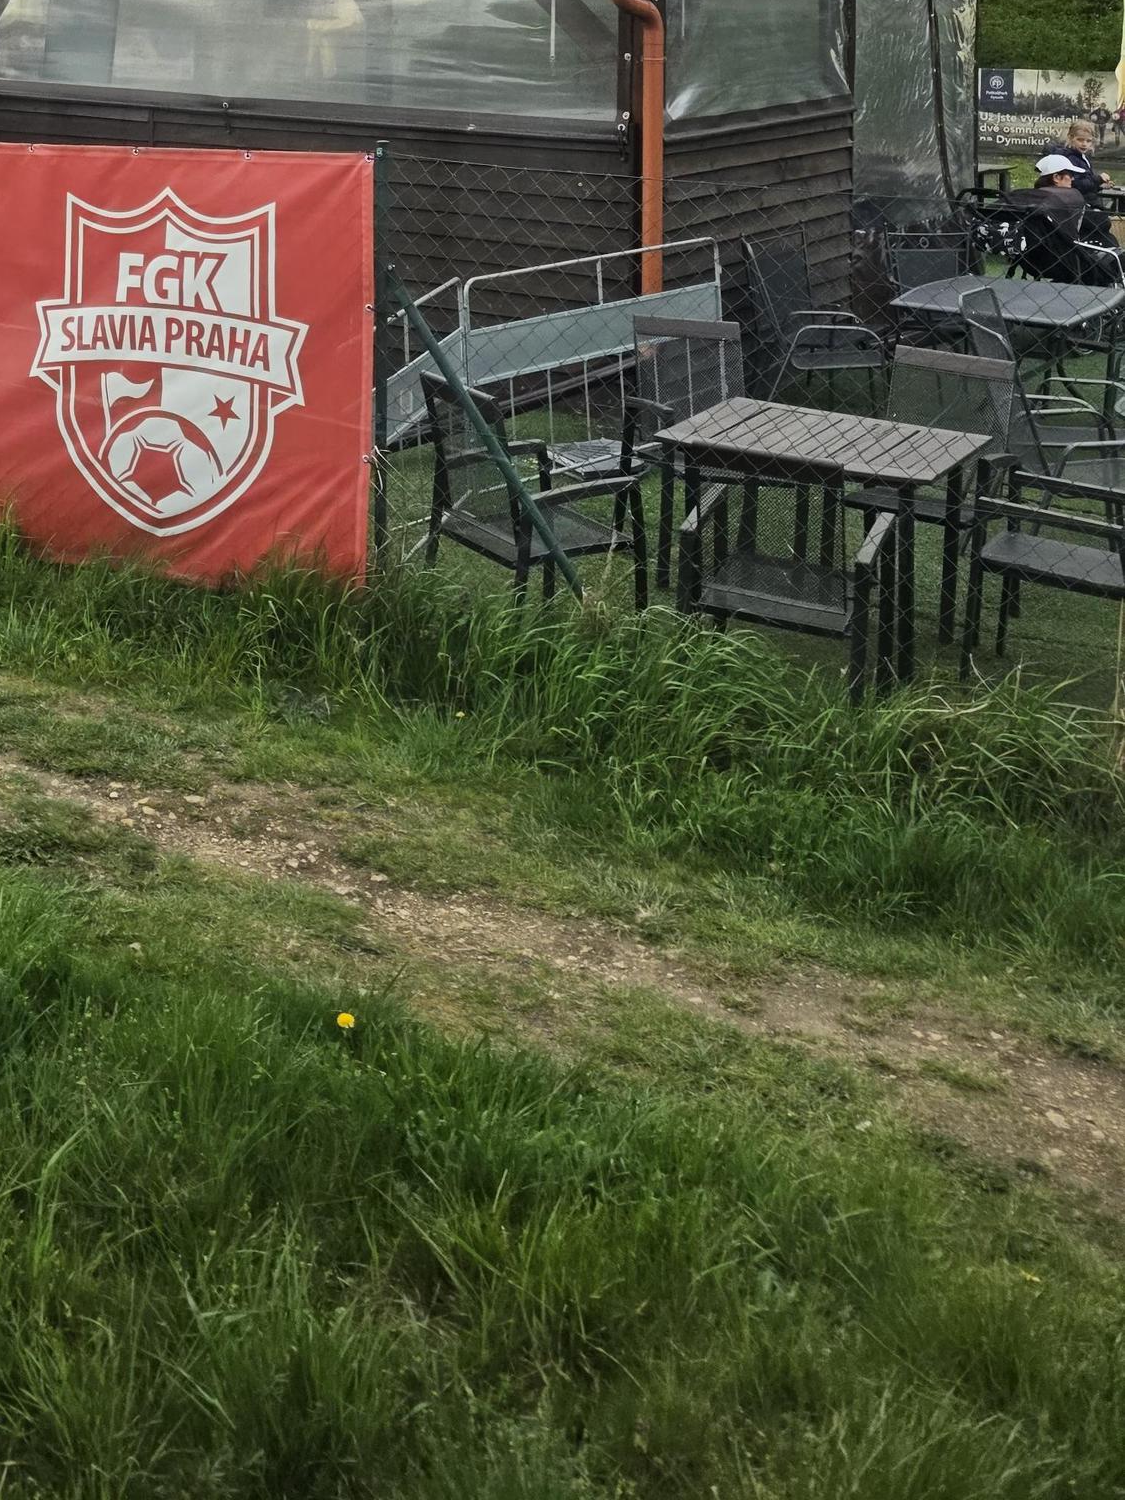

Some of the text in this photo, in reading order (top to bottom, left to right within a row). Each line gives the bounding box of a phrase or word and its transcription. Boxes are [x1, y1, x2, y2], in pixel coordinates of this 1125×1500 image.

[996, 113, 1017, 123] jste
[115, 252, 220, 311] FGK
[60, 314, 270, 372] SLAVIA PRAHA
